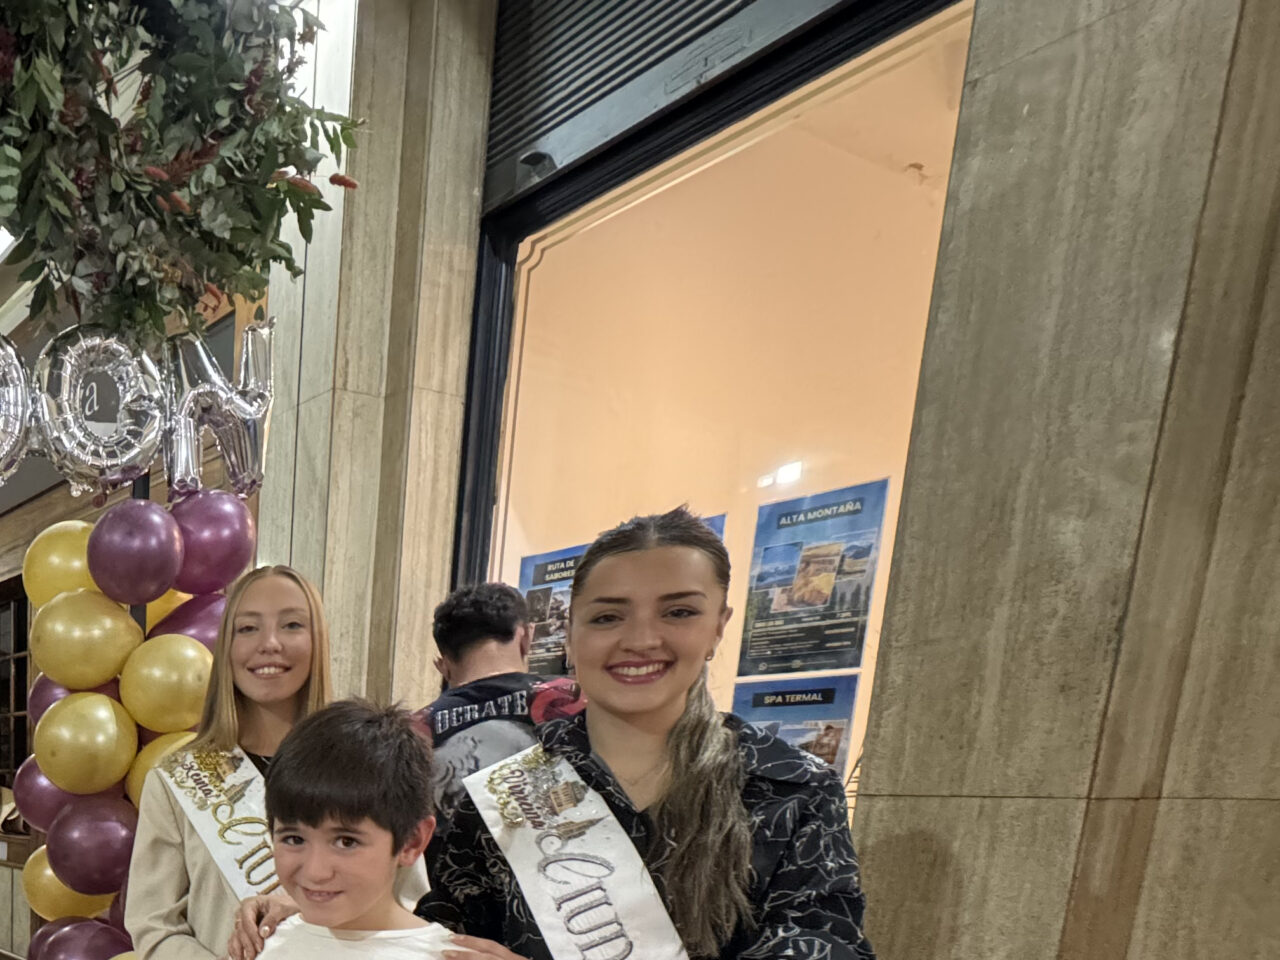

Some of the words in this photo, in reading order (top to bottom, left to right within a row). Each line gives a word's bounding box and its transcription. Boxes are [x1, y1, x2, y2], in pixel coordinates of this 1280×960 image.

[779, 514, 805, 527] ALTA
[807, 500, 862, 522] MONTAÑA
[547, 559, 565, 571] RUTA
[565, 558, 575, 569] DE
[764, 693, 783, 705] SPA
[785, 691, 824, 704] TERMAL
[181, 760, 217, 799] Reina
[503, 768, 546, 831] Virreina
